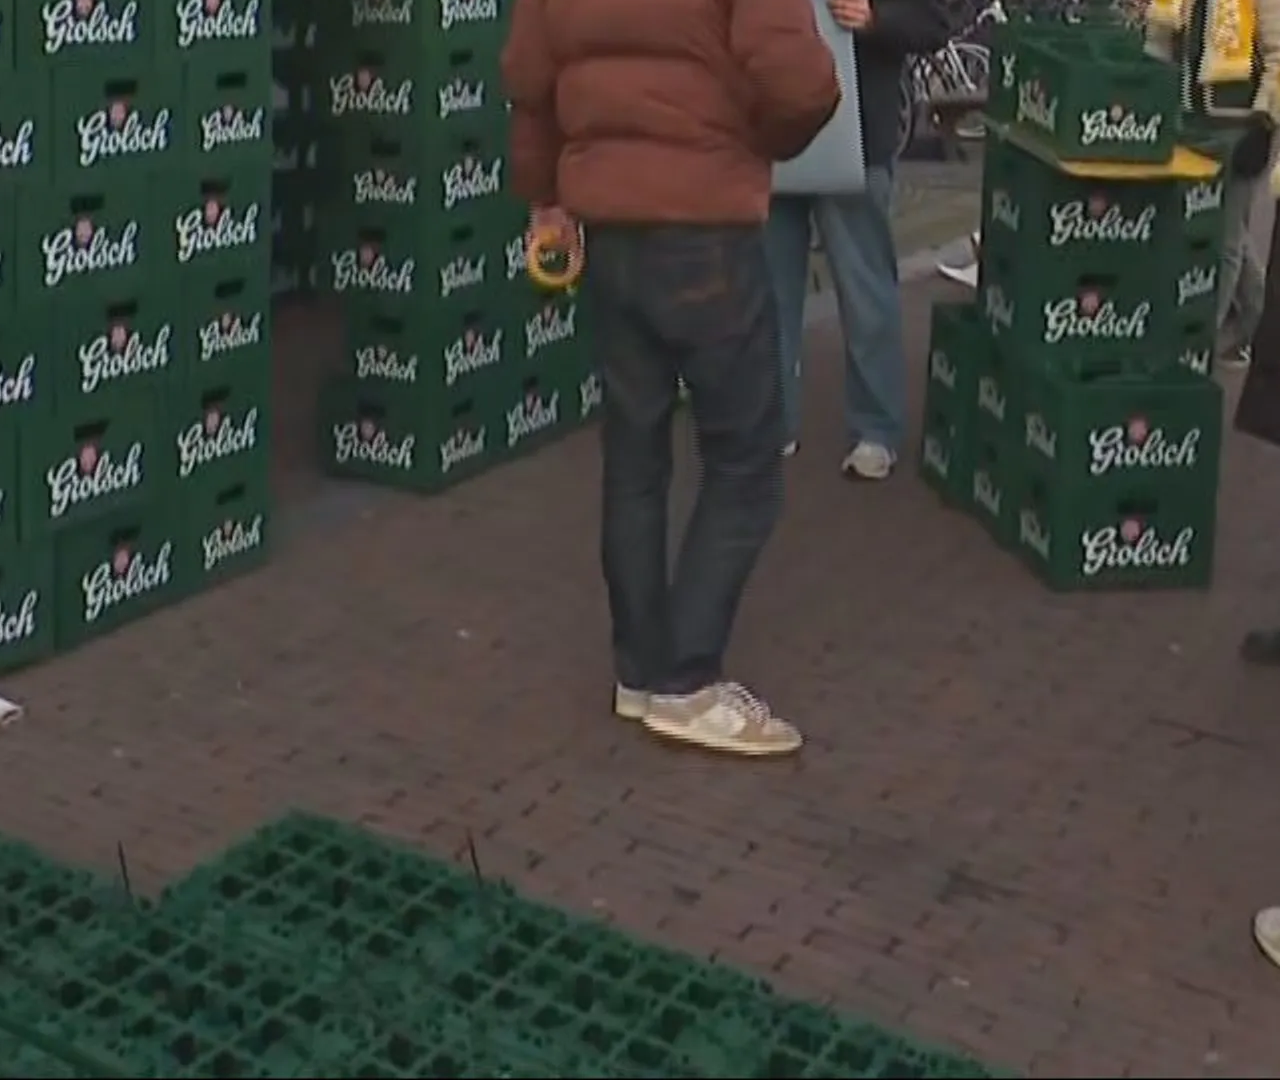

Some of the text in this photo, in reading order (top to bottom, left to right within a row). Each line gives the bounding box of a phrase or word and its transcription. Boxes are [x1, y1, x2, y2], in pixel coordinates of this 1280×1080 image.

[43, 0, 136, 53] Grolsch
[331, 75, 411, 113] Grolsch
[78, 102, 168, 166] Grolsch
[202, 105, 262, 151] Grolsch
[1082, 106, 1161, 145] Grolsch
[355, 170, 415, 203] Grolsch
[176, 203, 257, 262] Grolsch
[1051, 202, 1155, 245] Grolsch
[43, 219, 136, 286] Grolsch
[333, 251, 413, 292] Grolsch
[200, 313, 260, 360] Grolsch
[1045, 299, 1149, 342] Grolsch
[79, 325, 169, 392] Grolsch
[178, 408, 256, 476] Grolsch
[334, 423, 414, 468] Grolsch
[1090, 427, 1200, 474] Grolsch
[48, 443, 141, 517] Grolsch
[1083, 526, 1192, 574] Grolsch
[83, 542, 171, 621] Grolsch
